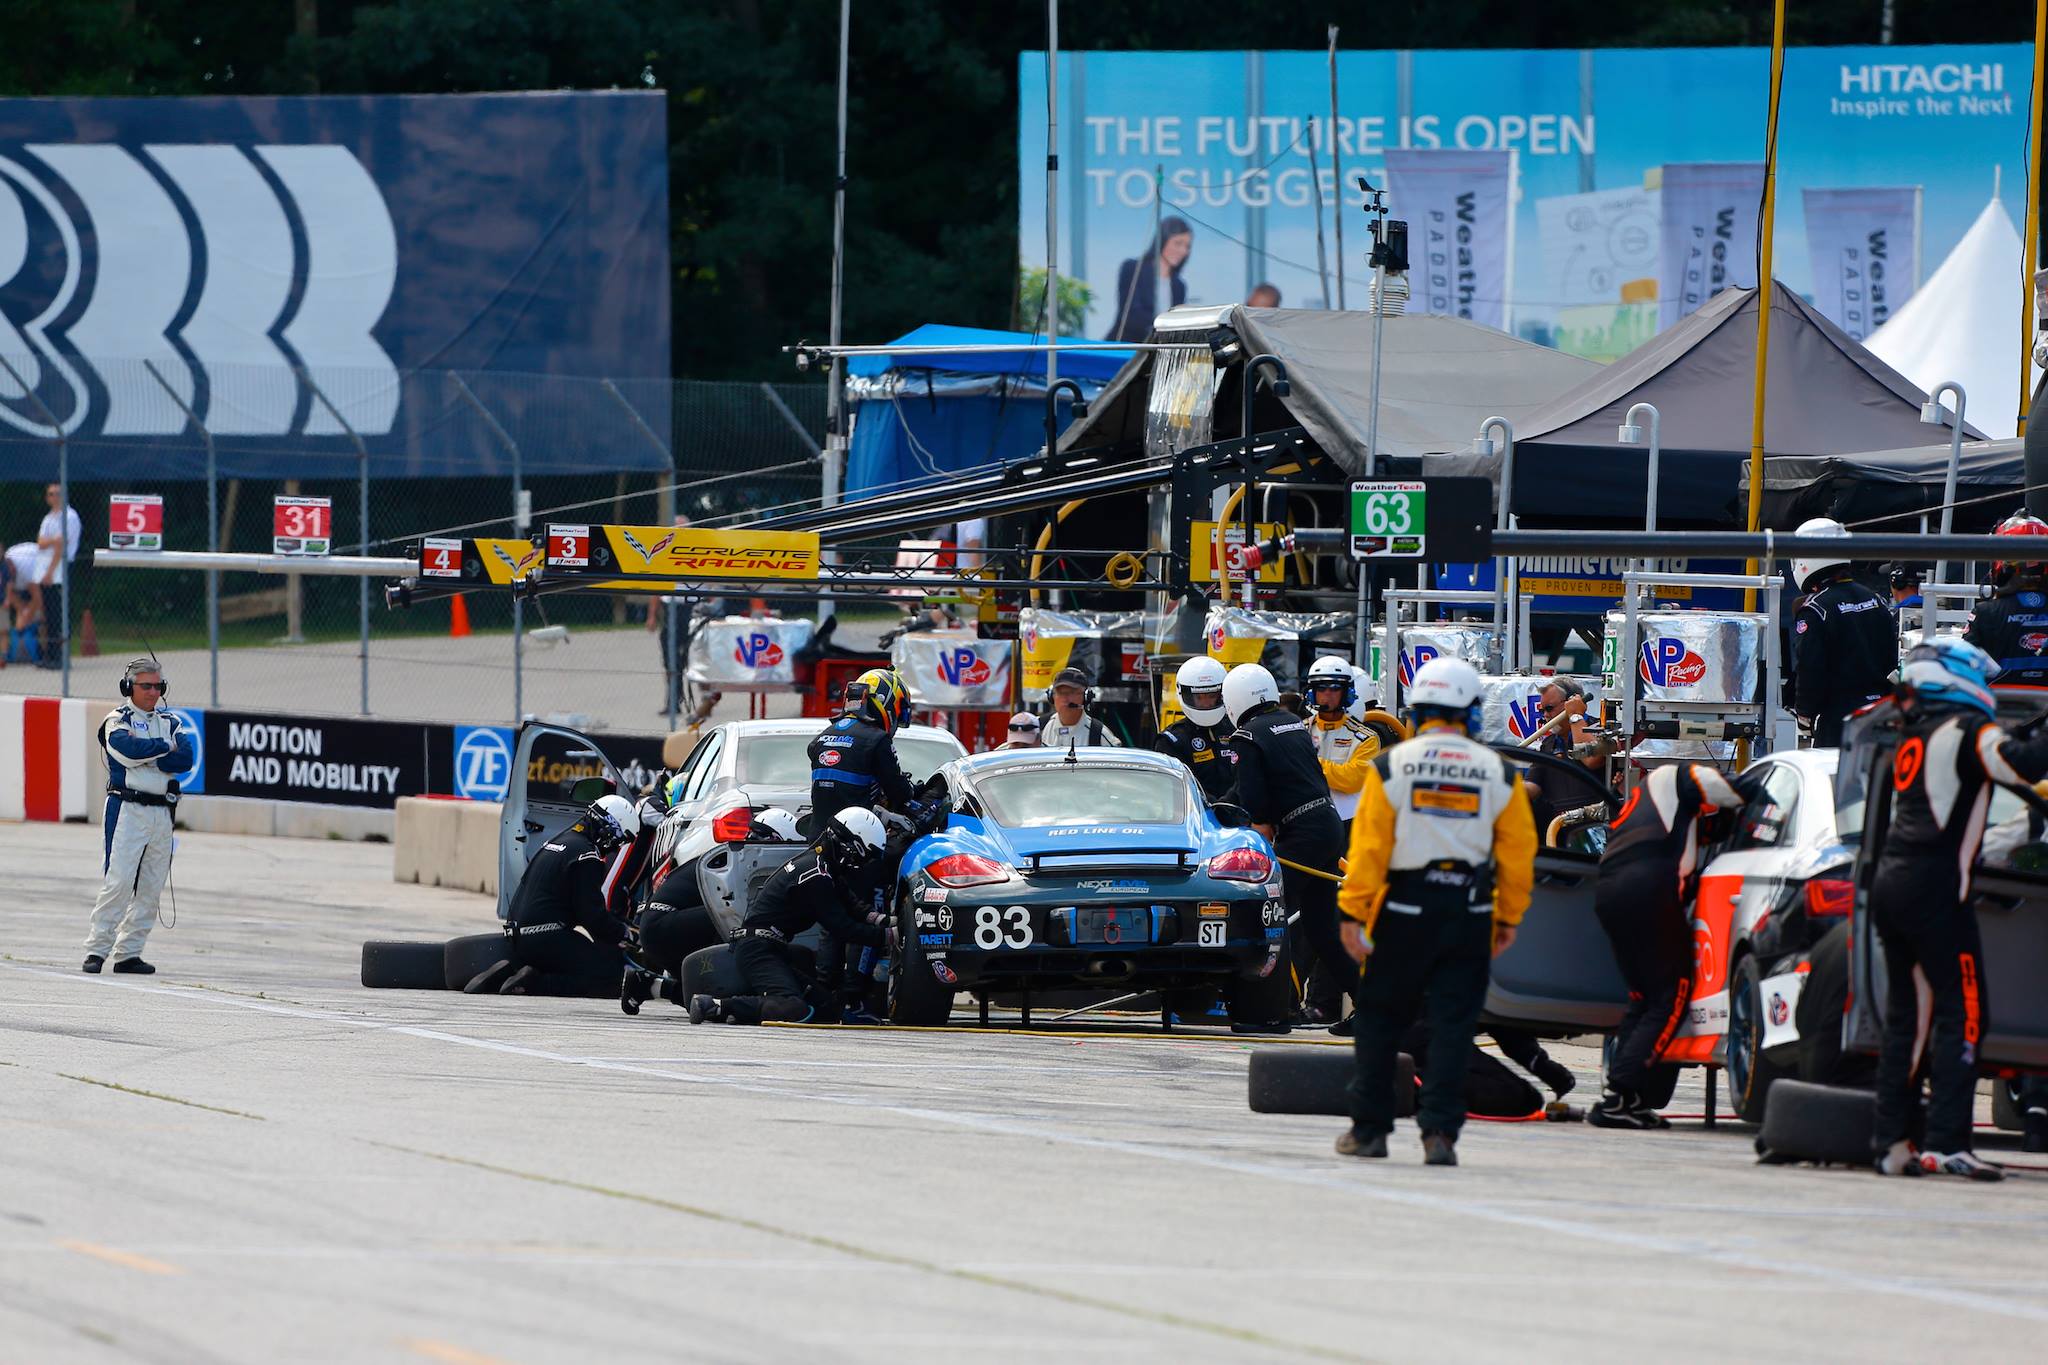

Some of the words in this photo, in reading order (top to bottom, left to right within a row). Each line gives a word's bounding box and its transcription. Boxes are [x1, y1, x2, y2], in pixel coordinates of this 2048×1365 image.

[1840, 64, 2003, 93] HITACHI
[1831, 97, 1909, 119] Inspire
[1917, 96, 1952, 115] the
[1960, 95, 2012, 115] Next
[1085, 116, 1181, 156] THE
[1197, 116, 1384, 156] FUTURE
[1400, 115, 1441, 150] IS
[1454, 114, 1595, 155] OPEN
[1085, 168, 1154, 208] TO
[1173, 167, 1391, 208] SUGGEST
[126, 504, 146, 532] 5
[285, 506, 322, 537] 31
[1366, 492, 1411, 534] 63
[434, 549, 450, 569] 4
[561, 536, 576, 558] 3
[671, 546, 812, 558] CORVETTE
[1226, 543, 1245, 570] 3
[668, 557, 807, 570] RACING
[1546, 581, 1592, 592] PROVEN
[736, 633, 769, 668] VP
[1642, 637, 1685, 687] VP
[1669, 662, 1706, 681] Racing
[940, 648, 976, 685] VP
[229, 722, 322, 756] MOTION
[229, 755, 282, 784] AND
[287, 759, 400, 794] MOBILITY
[460, 745, 505, 793] ZF
[1403, 763, 1489, 780] OFFICIAL
[1048, 829, 1079, 837] RED
[940, 908, 952, 929] GT
[974, 906, 1033, 950] 83
[919, 934, 953, 945] TARETT
[1201, 923, 1223, 944] ST
